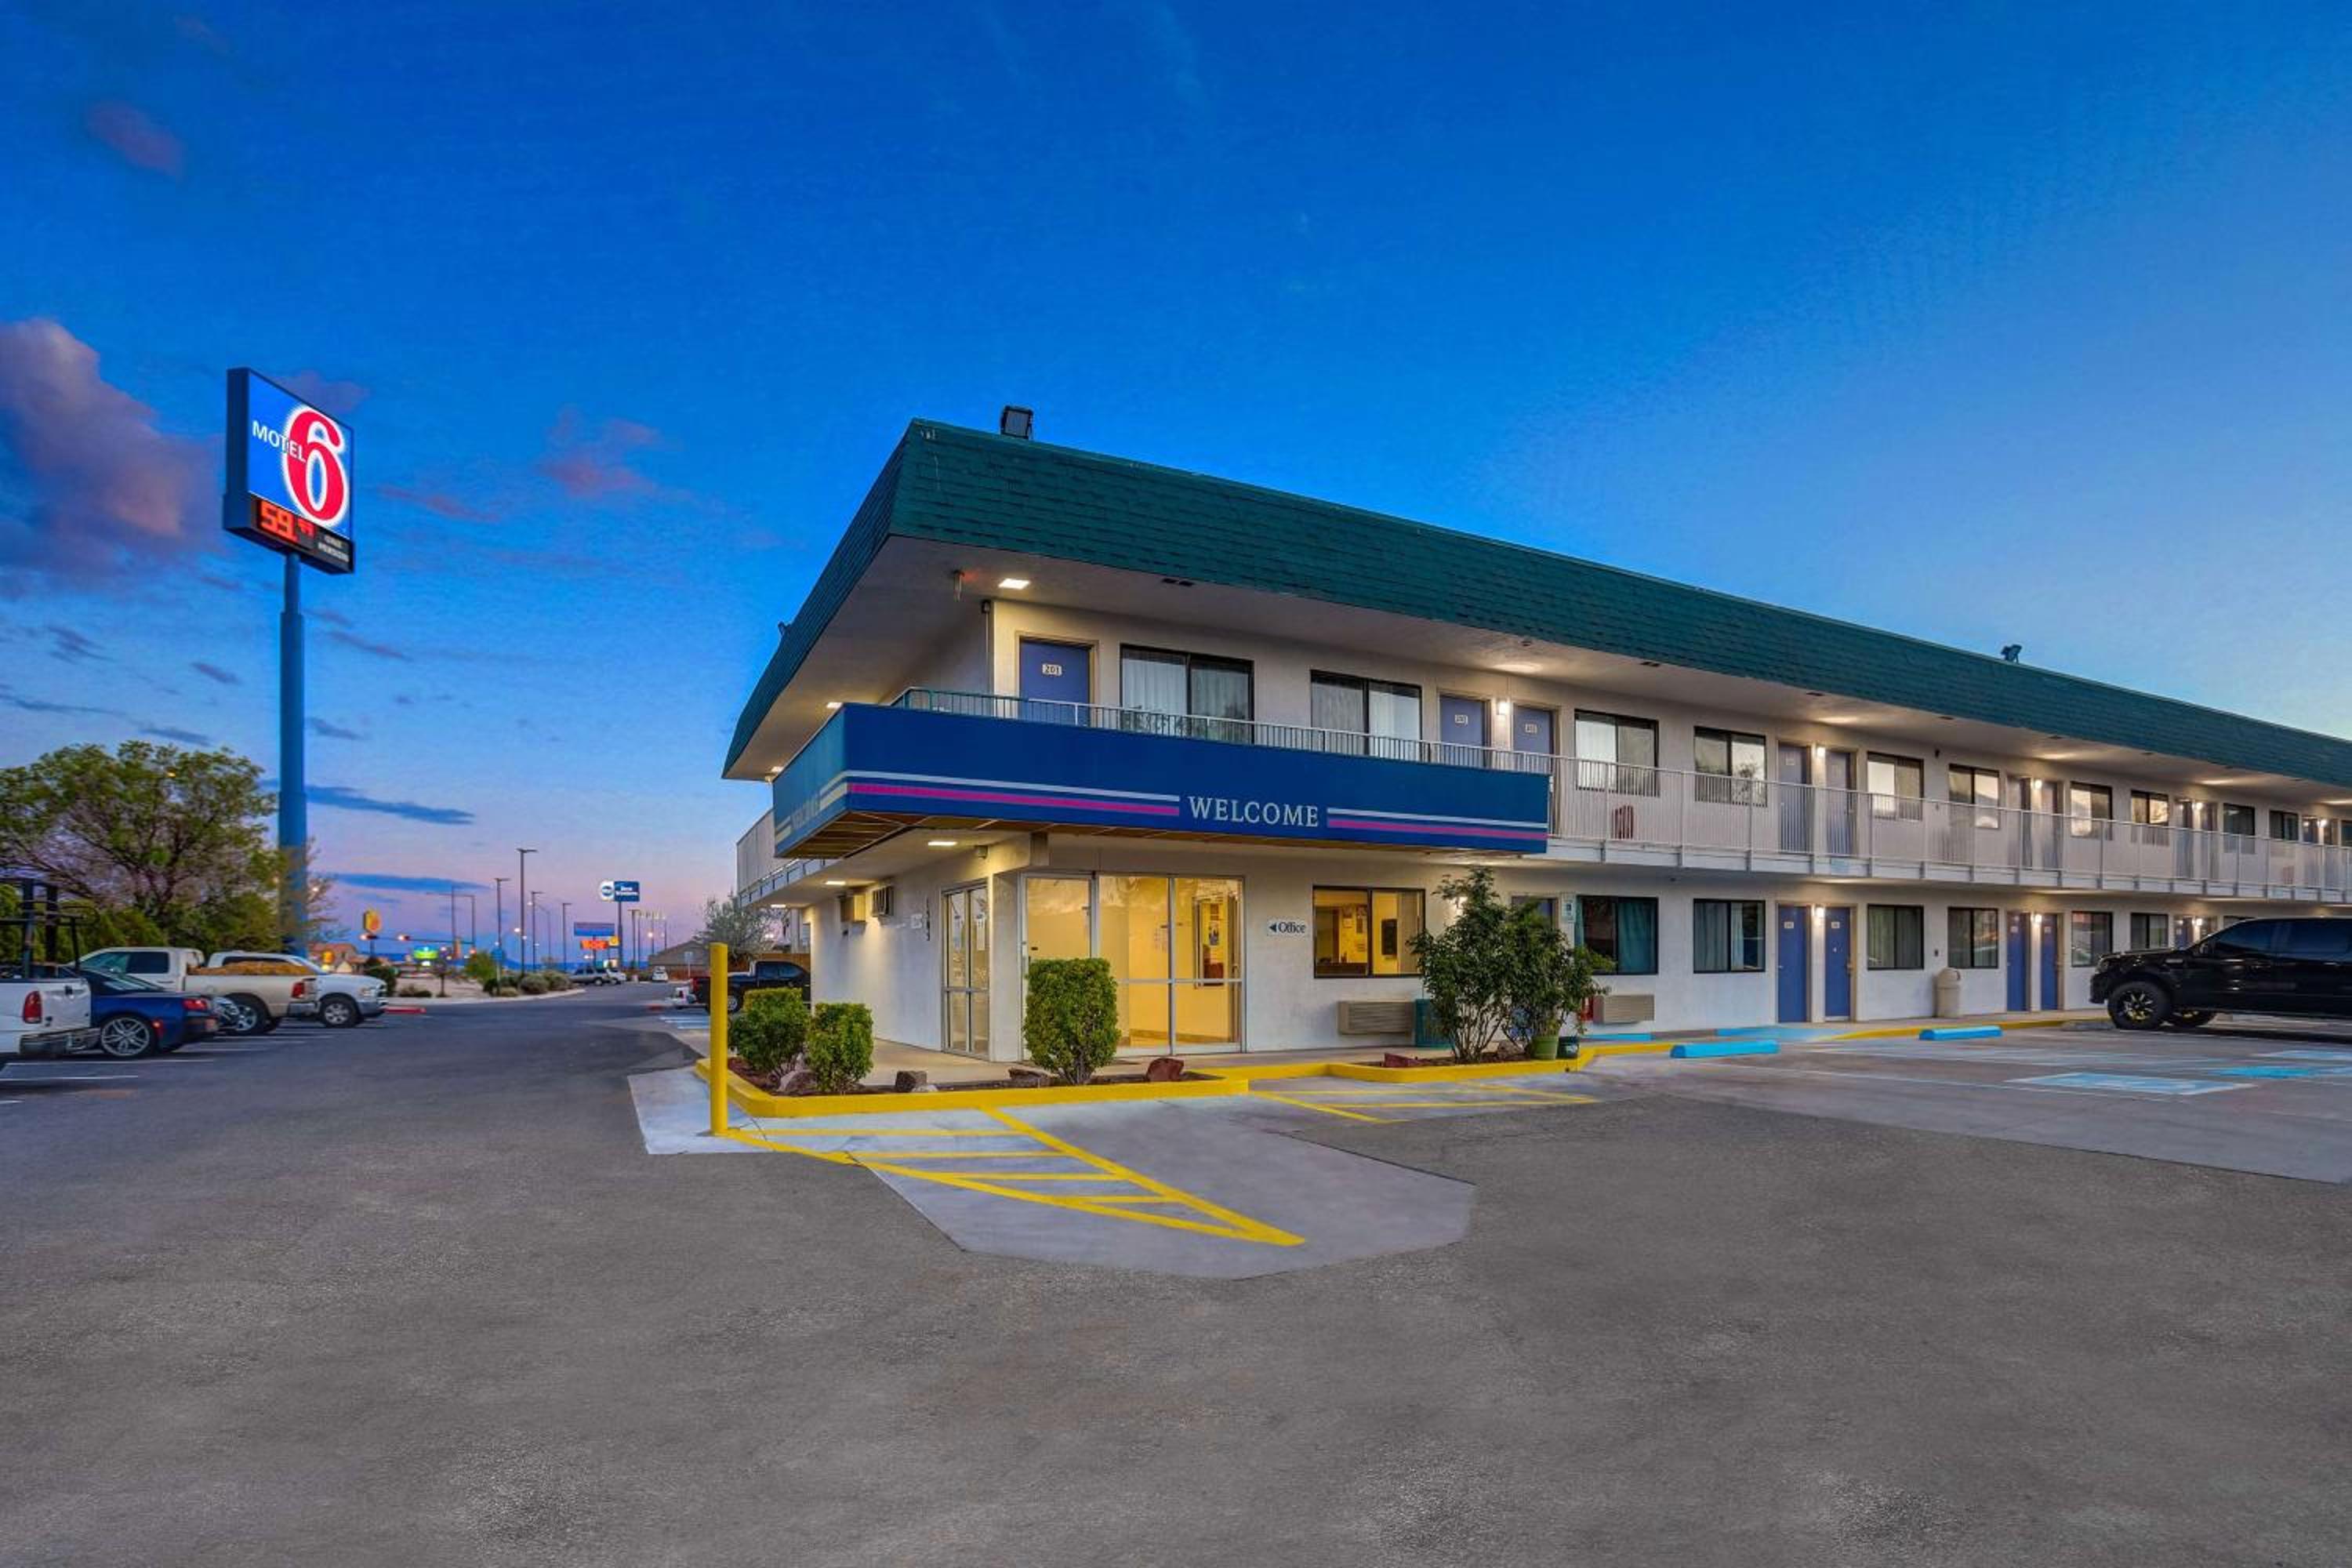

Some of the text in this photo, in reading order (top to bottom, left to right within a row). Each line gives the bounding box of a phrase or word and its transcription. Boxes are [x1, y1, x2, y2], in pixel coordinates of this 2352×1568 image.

[252, 406, 348, 525] MOTEL 6
[260, 500, 298, 542] 59
[1188, 796, 1318, 827] WELCOME
[1279, 921, 1307, 934] Office
